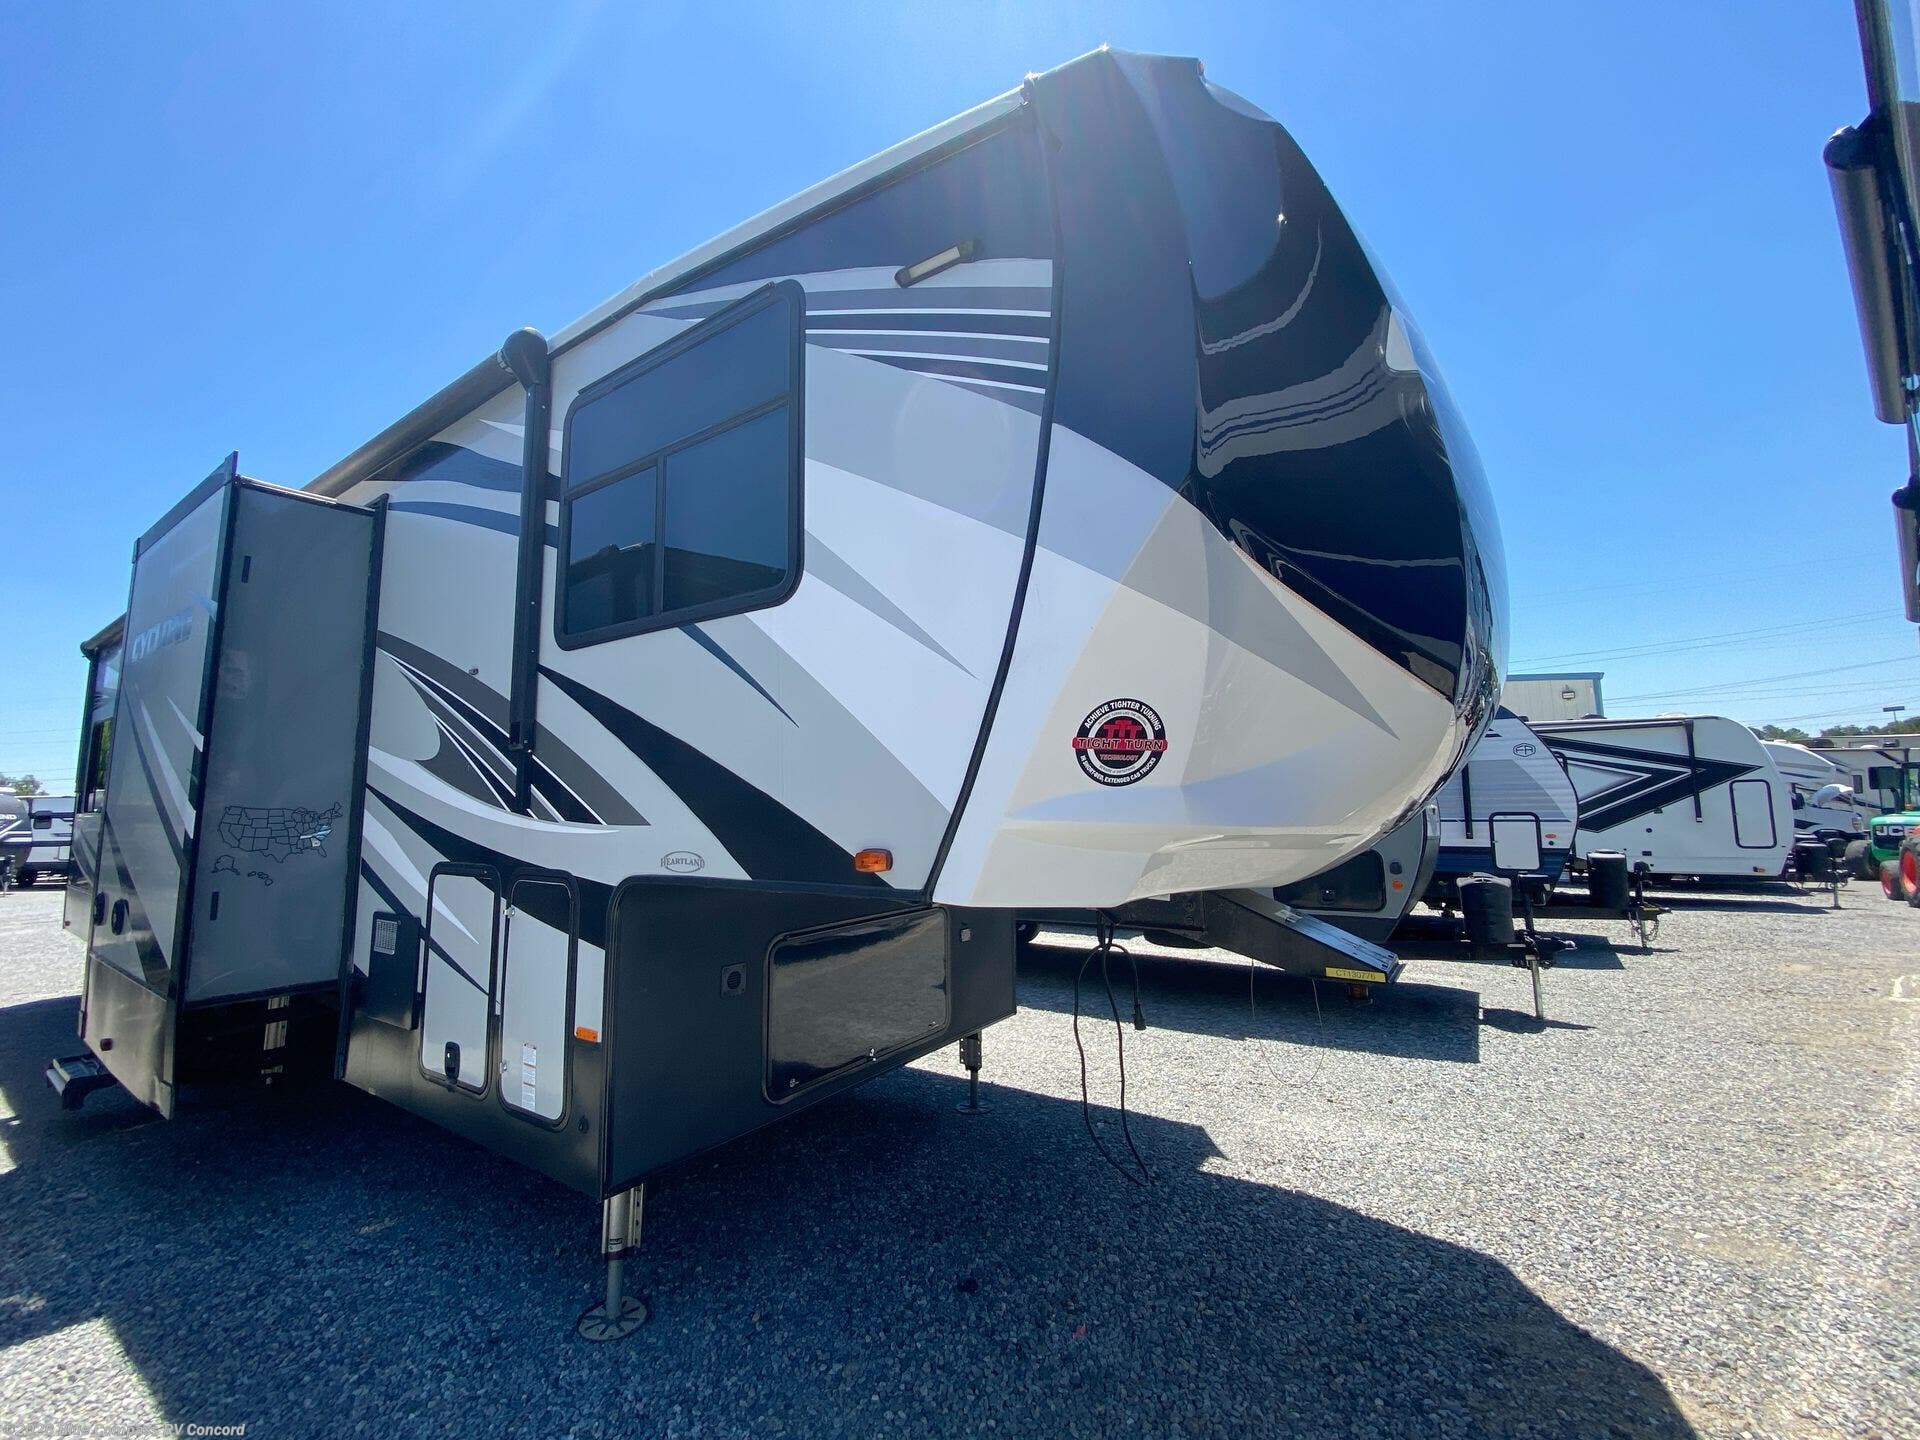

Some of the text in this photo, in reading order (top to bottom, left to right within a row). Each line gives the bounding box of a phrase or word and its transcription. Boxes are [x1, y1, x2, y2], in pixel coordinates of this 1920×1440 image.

[1084, 704, 1110, 729] ACHIEVE
[1110, 700, 1141, 710] TIGHTER
[1140, 705, 1162, 731] TURNING
[1077, 737, 1163, 751] TIGHT TURN
[1104, 776, 1131, 784] EXTENDED
[660, 857, 705, 869] HEARTLAND
